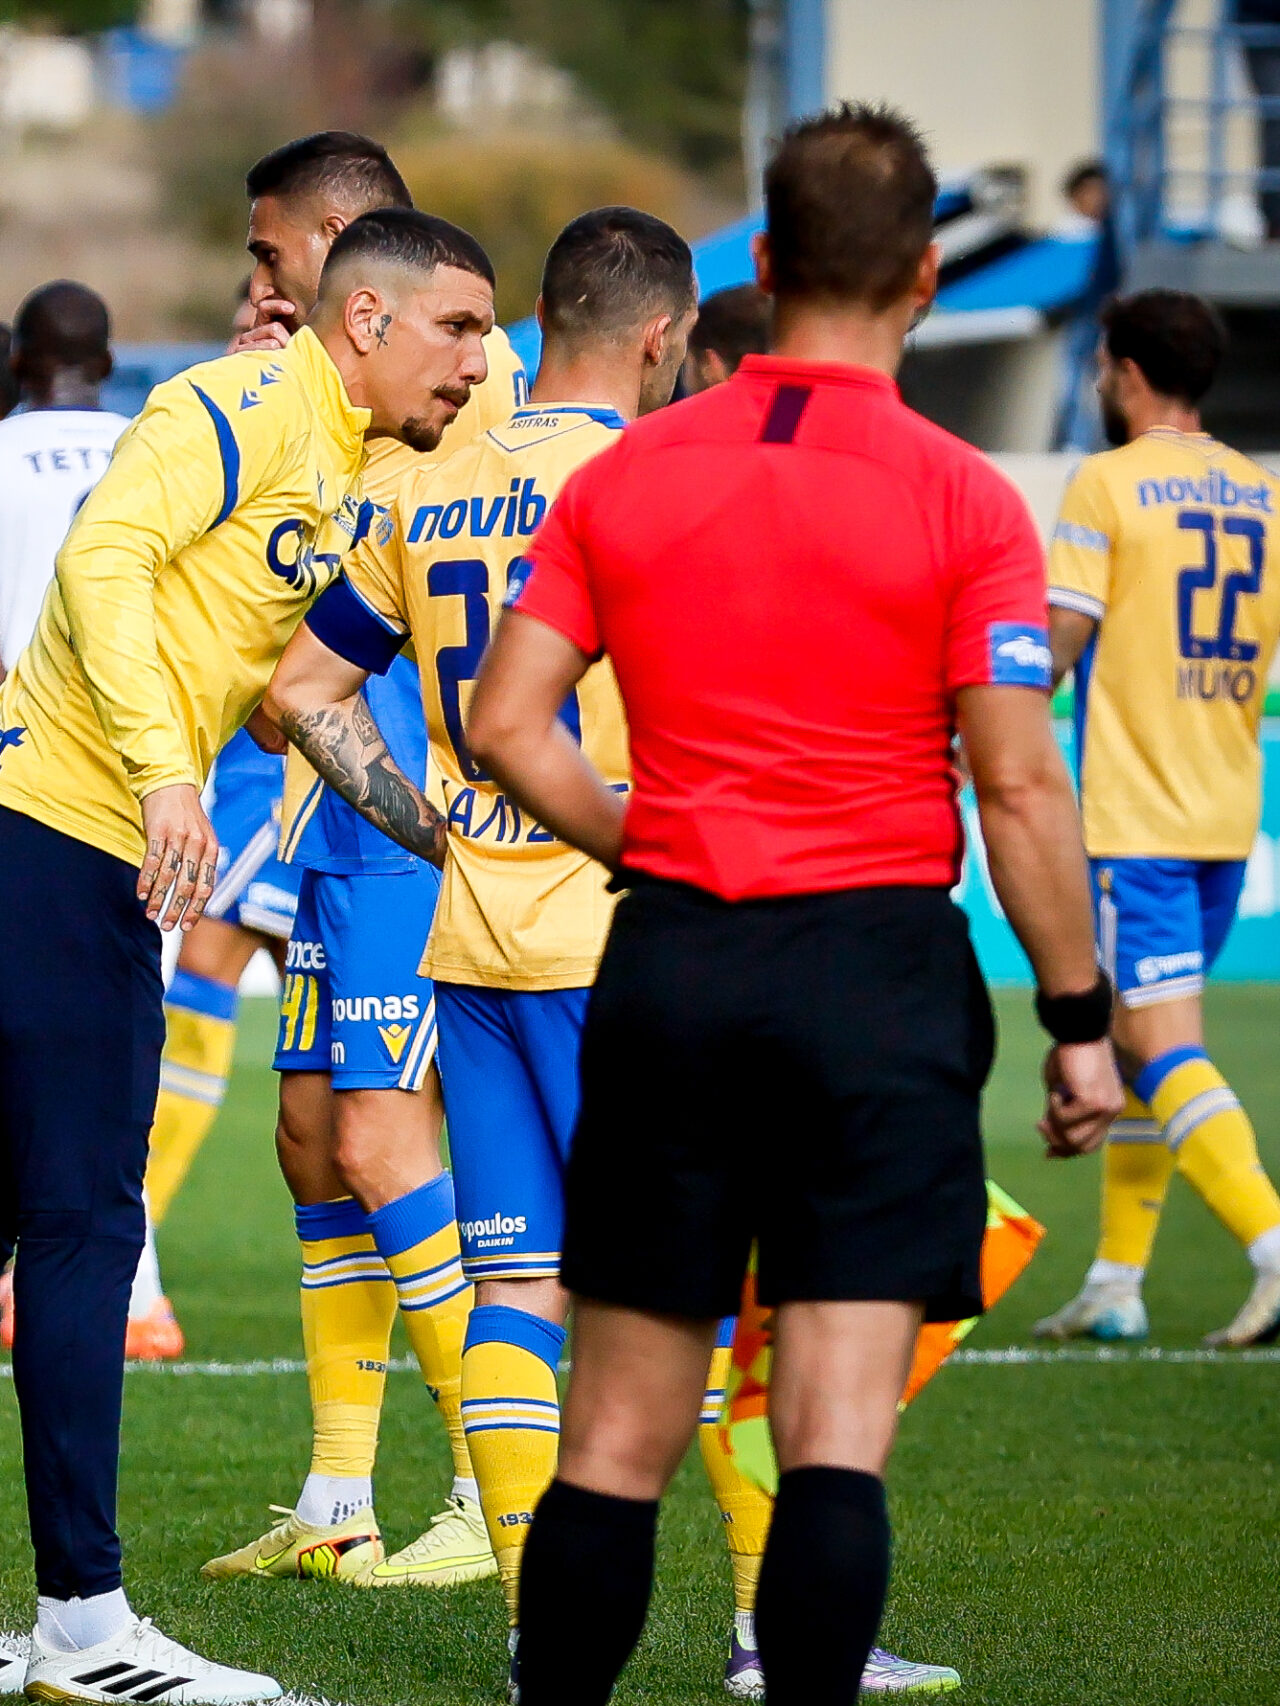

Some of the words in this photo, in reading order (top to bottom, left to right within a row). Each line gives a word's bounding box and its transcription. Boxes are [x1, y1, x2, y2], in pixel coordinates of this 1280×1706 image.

[1139, 469, 1273, 512] novibet
[1177, 512, 1266, 661] 22
[281, 973, 319, 1051] 41
[477, 1236, 515, 1249] DAIKIN
